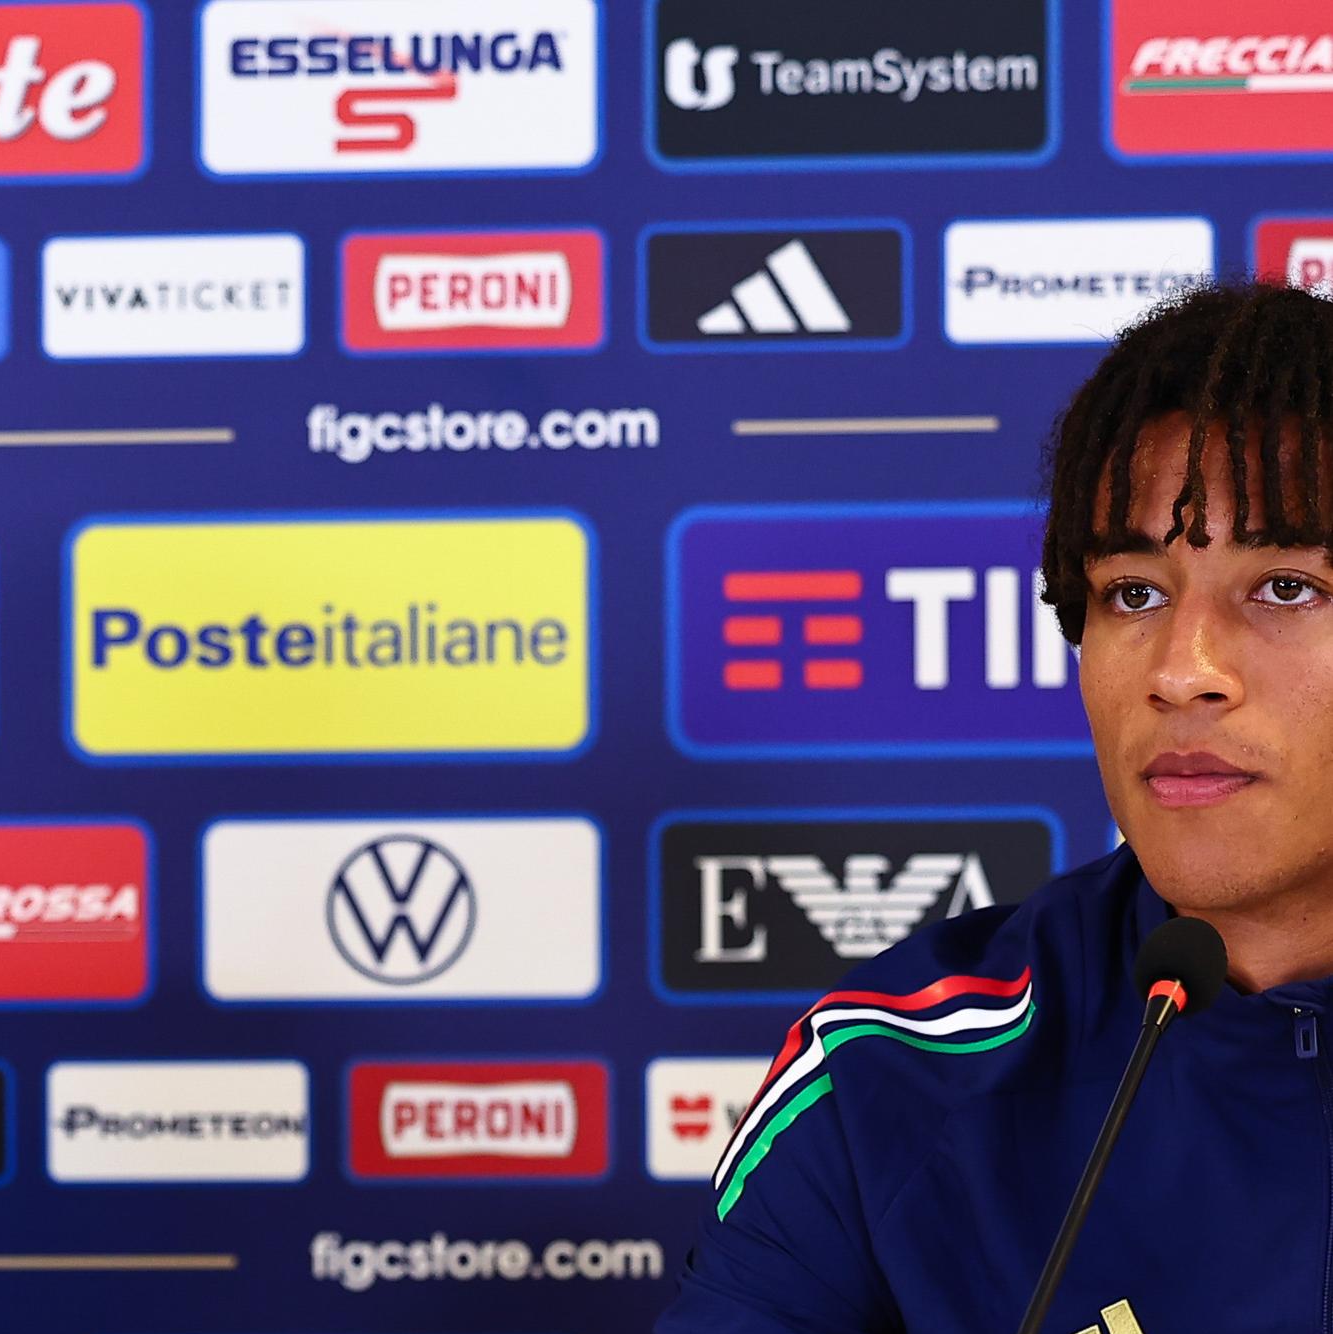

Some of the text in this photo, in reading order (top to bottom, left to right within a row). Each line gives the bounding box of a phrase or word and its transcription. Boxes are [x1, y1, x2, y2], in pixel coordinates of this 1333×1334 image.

[228, 31, 563, 78] ESSELUNGA
[751, 48, 1039, 102] TeamSystem
[55, 282, 291, 313] VIVATICKET
[387, 271, 559, 313] PERONI
[307, 403, 660, 463] figcstore.com
[60, 1105, 306, 1139] PROMETEON
[393, 1099, 564, 1142] PERONI
[310, 1231, 665, 1291] figcstore.com
